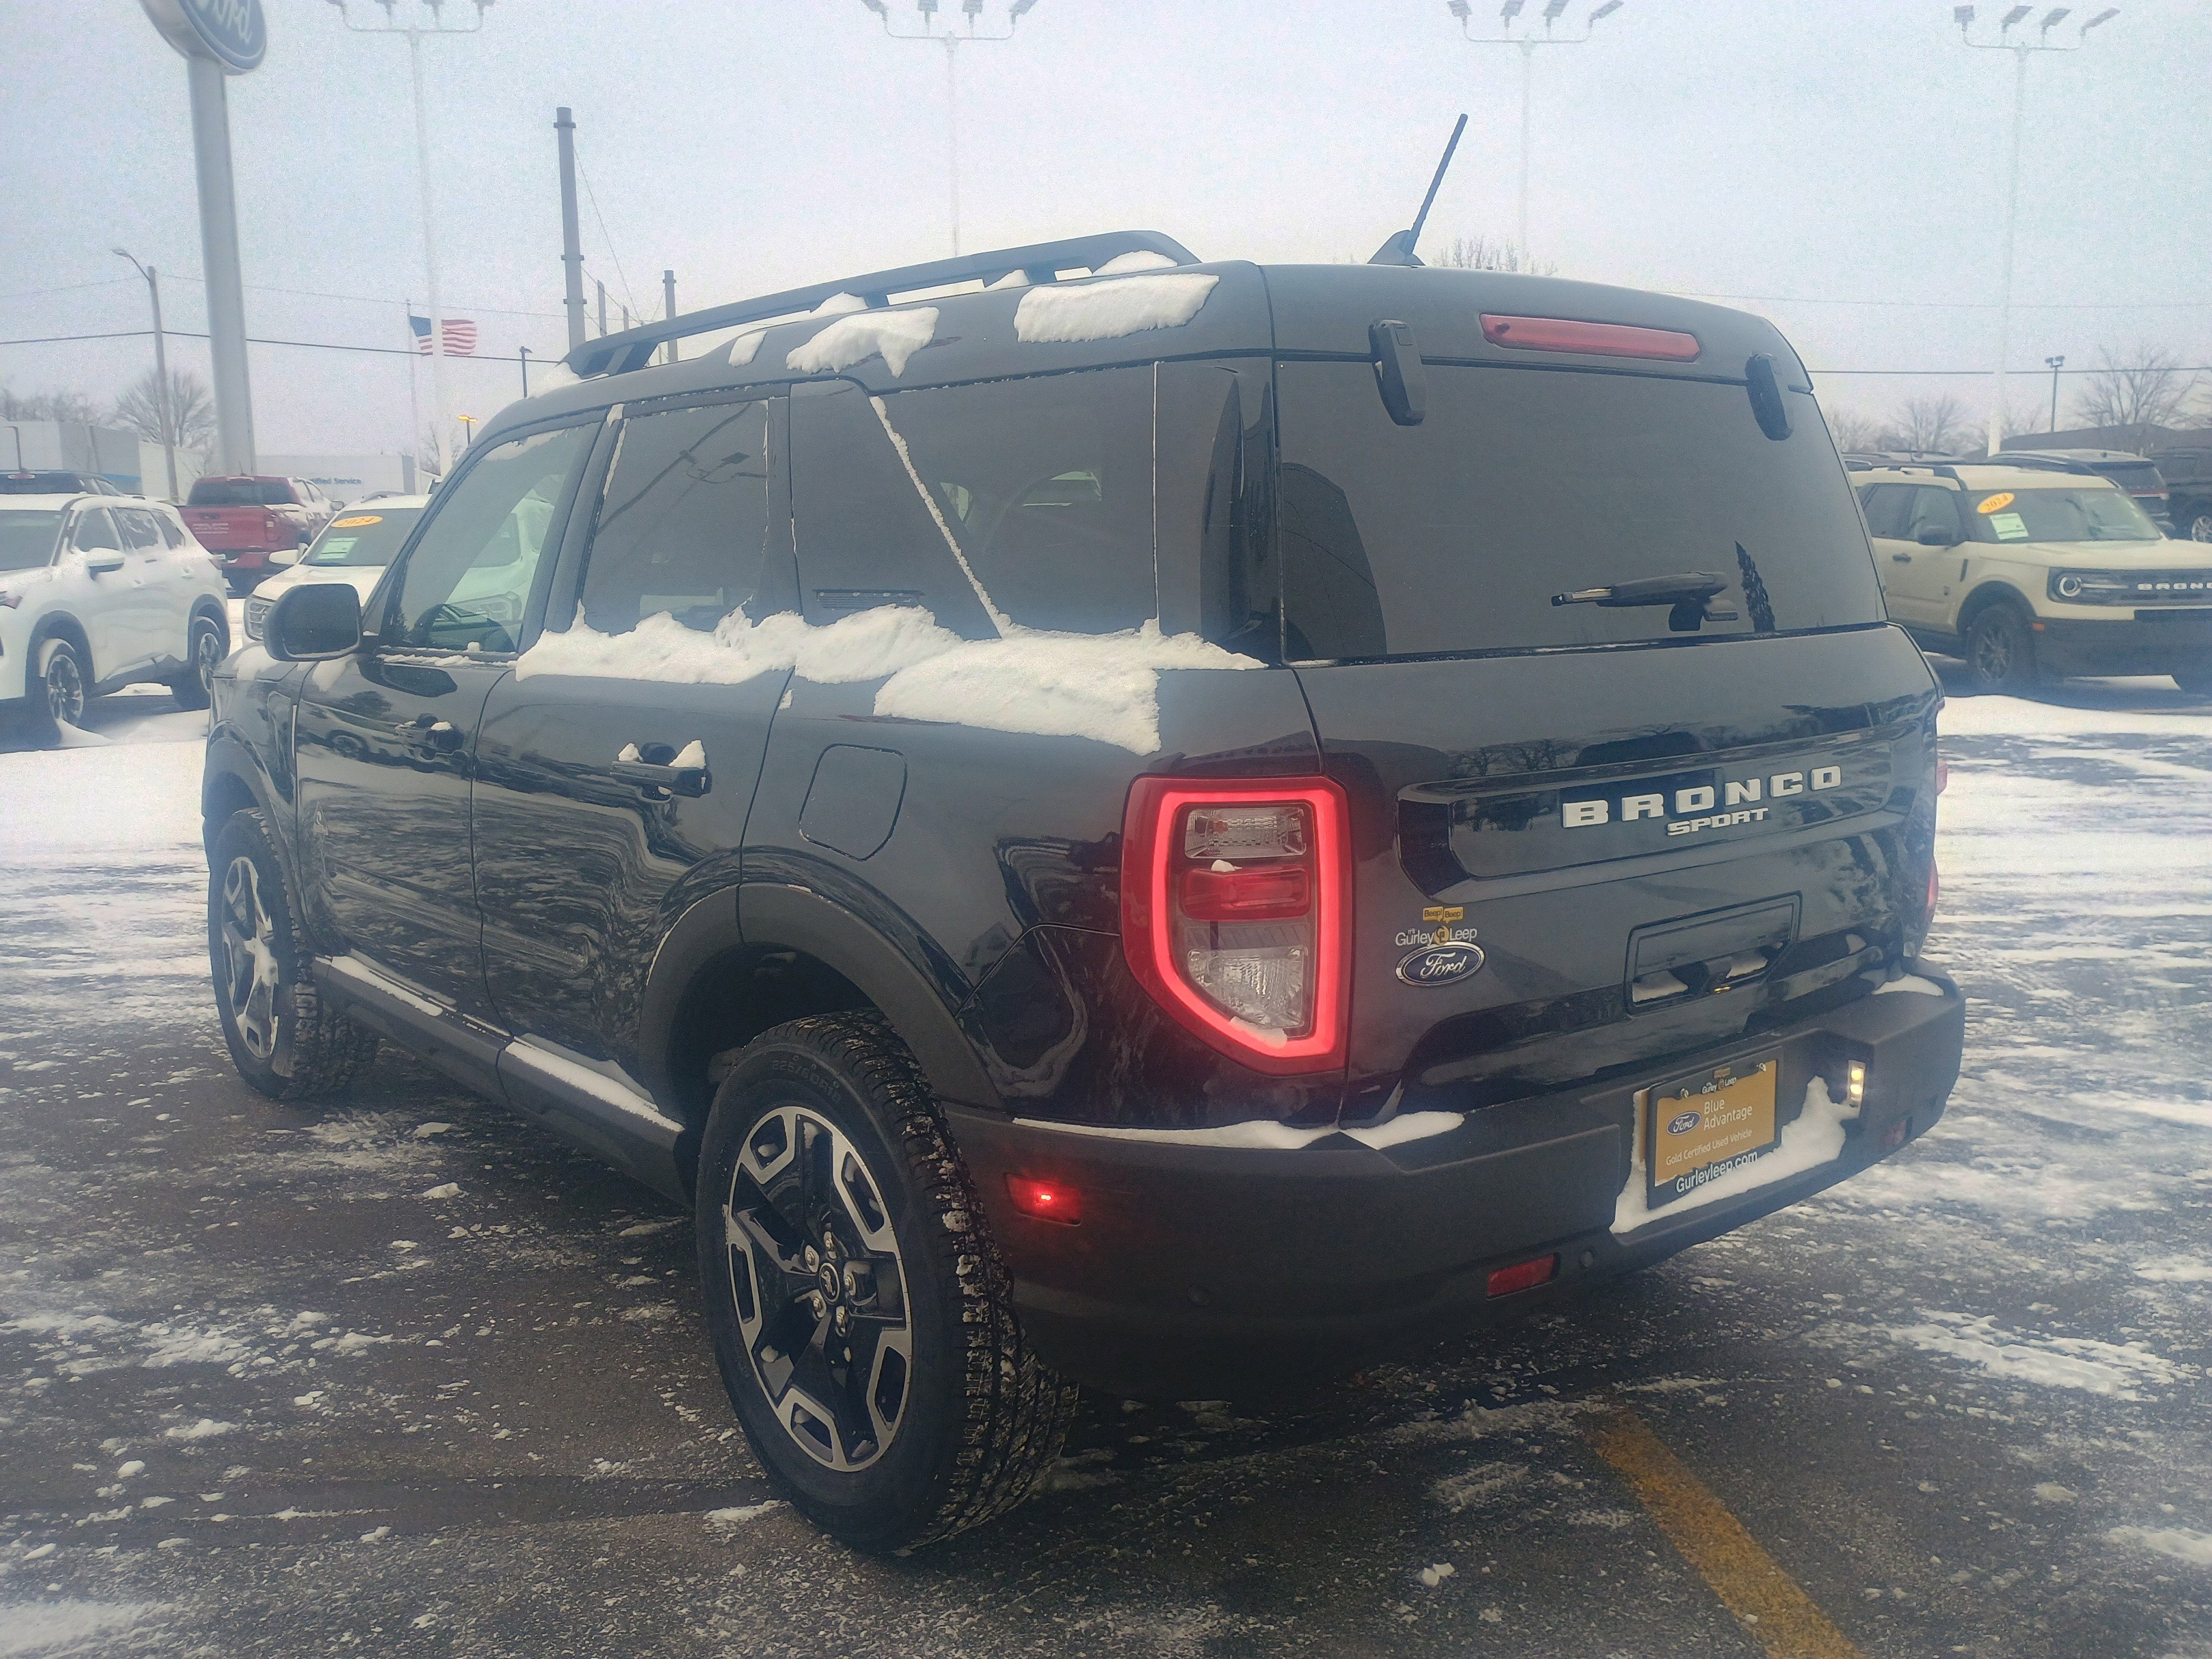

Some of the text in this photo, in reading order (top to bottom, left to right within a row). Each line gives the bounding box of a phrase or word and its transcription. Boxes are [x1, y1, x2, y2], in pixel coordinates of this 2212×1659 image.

[197, 0, 252, 44] ord
[1562, 765, 1841, 828] BRONCO
[1667, 807, 1769, 836] SPORT
[1424, 908, 1462, 918] Beep! Beep!
[1395, 929, 1434, 947] Gurley
[1449, 928, 1478, 942] Leep
[1420, 952, 1467, 979] Ford
[1703, 1106, 1753, 1131] Advantage
[1704, 1099, 1725, 1115] Blue
[1673, 1115, 1695, 1132] Ford
[1666, 1128, 1752, 1165] Gold Certified Used Vehicle
[1676, 1151, 1758, 1193] Gurleyleep.com
